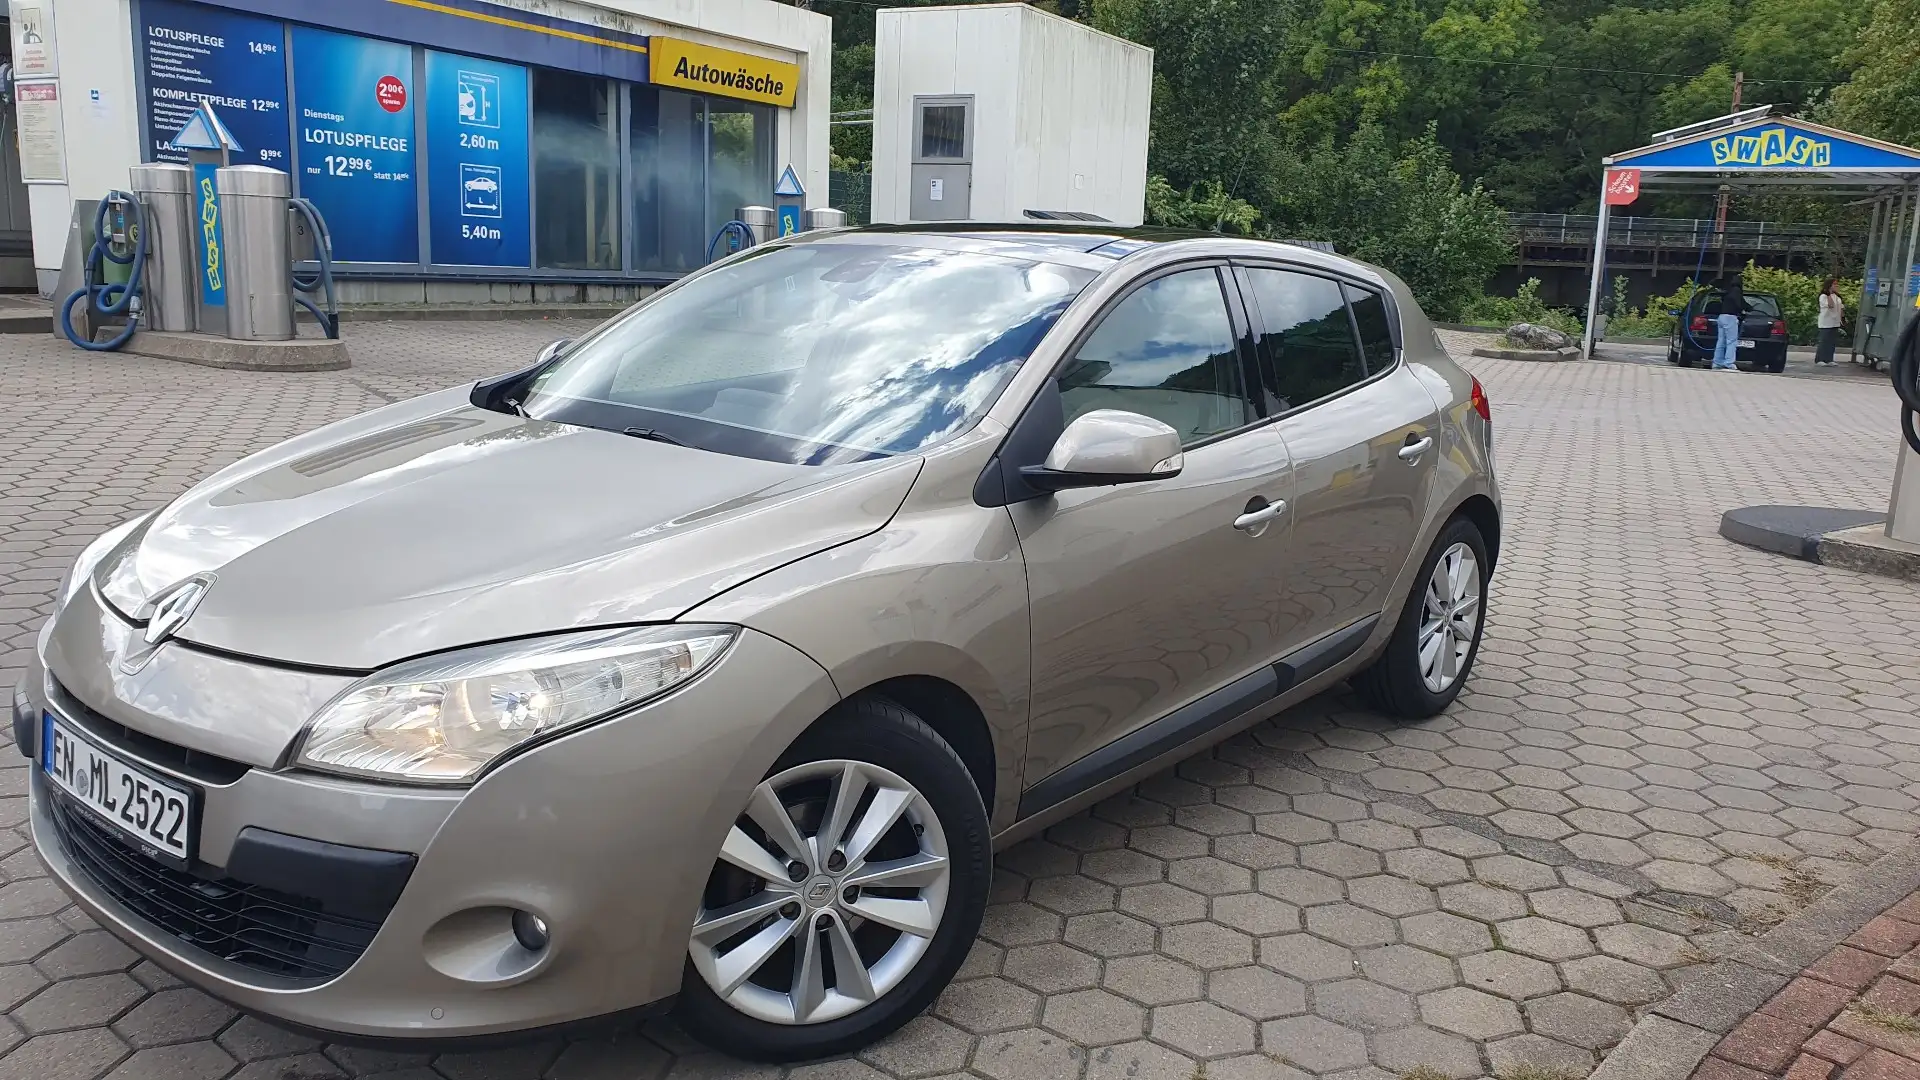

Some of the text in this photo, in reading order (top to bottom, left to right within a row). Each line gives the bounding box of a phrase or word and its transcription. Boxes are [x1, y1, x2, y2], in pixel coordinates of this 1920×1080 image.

[149, 26, 225, 48] LOTUSPFLEGE
[674, 56, 784, 96] Autowäsche
[153, 87, 247, 109] KOMPLETTPFLEGE
[304, 108, 345, 123] Dienstags
[305, 128, 408, 152] LOTUSPFLEGE
[460, 133, 499, 150] 2,60 m
[1711, 128, 1831, 167] SWASH
[307, 166, 321, 175] nur
[373, 172, 391, 180] statt
[201, 179, 221, 290] SWASH
[296, 225, 304, 236] 3
[462, 225, 501, 240] 5,40 m
[54, 728, 75, 787] EN
[90, 752, 116, 812] ML
[120, 773, 184, 850] 2522
